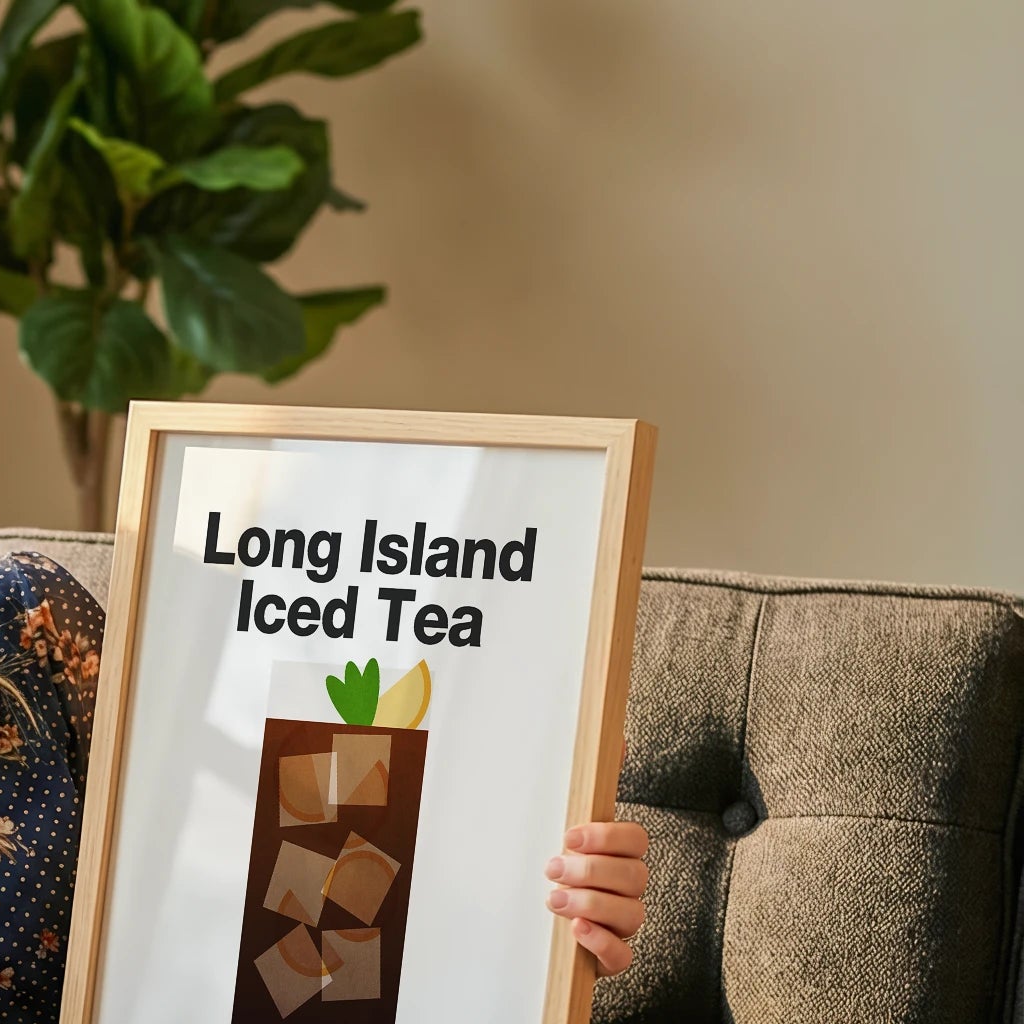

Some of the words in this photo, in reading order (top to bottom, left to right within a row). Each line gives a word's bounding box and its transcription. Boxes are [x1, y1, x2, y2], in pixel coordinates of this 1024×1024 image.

[204, 512, 342, 583] Long
[360, 519, 537, 582] Island
[237, 580, 359, 639] Iced
[378, 587, 483, 647] Tea
